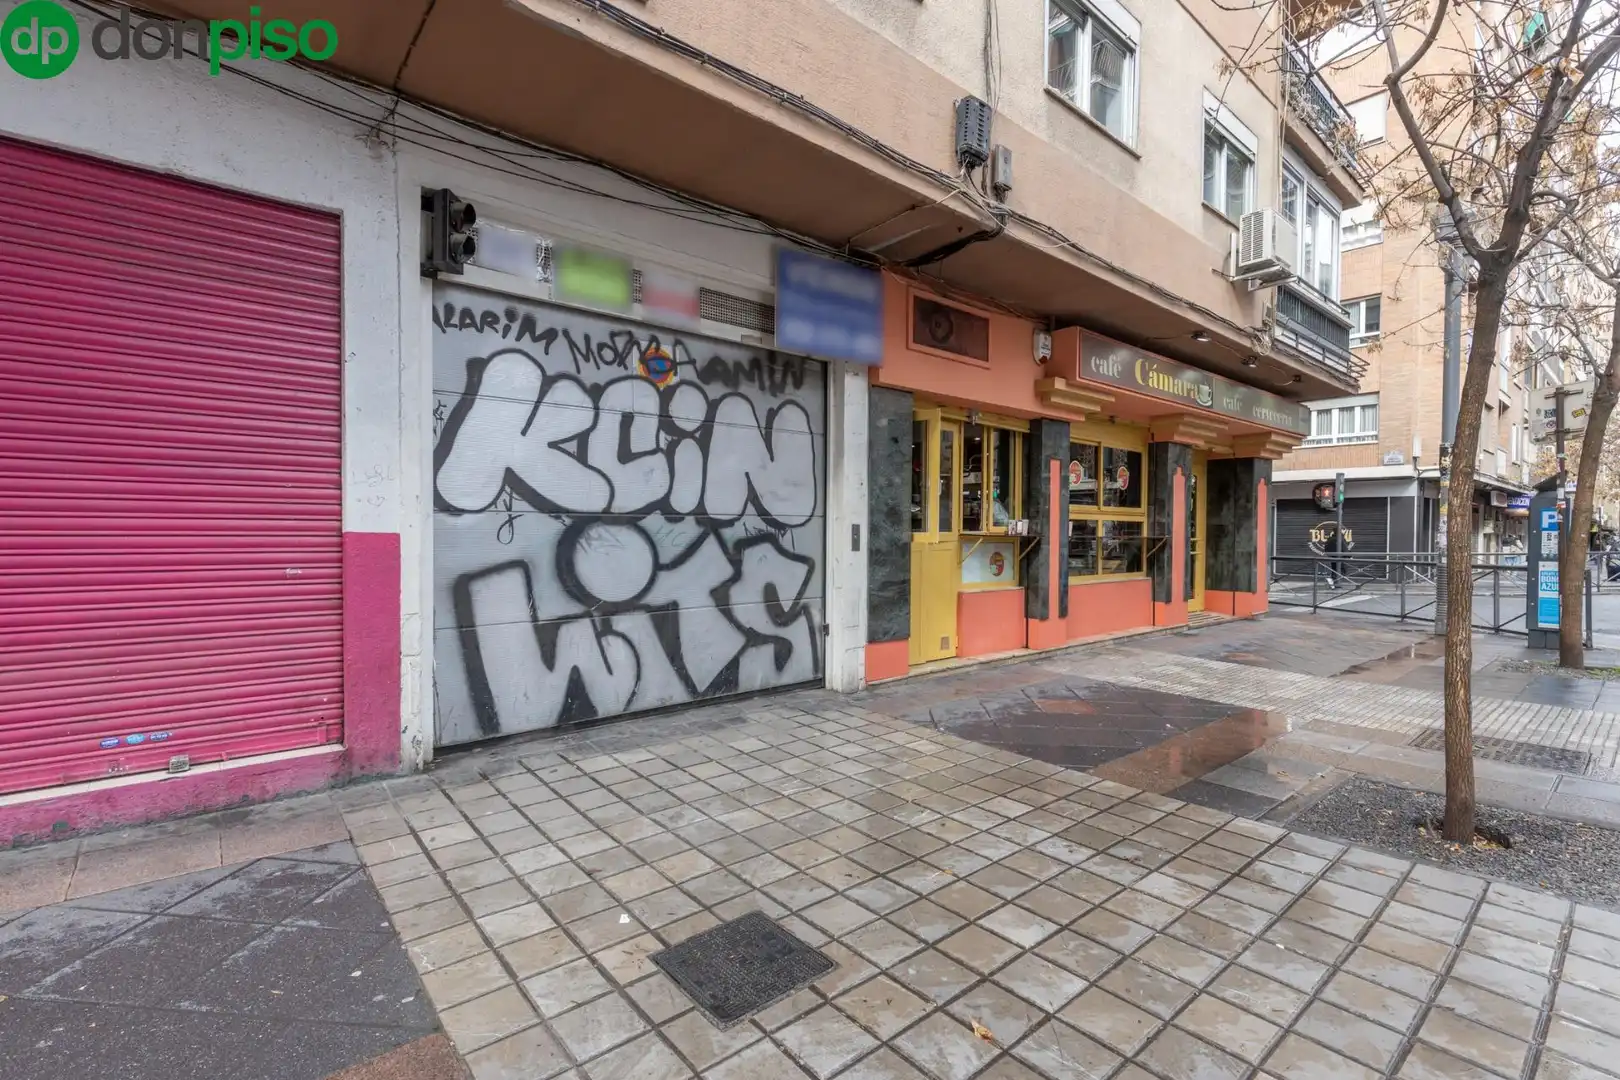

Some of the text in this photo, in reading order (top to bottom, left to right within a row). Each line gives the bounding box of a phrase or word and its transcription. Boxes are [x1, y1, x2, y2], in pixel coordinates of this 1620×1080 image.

[1090, 354, 1199, 400] café Cámara
[1541, 510, 1559, 530] P
